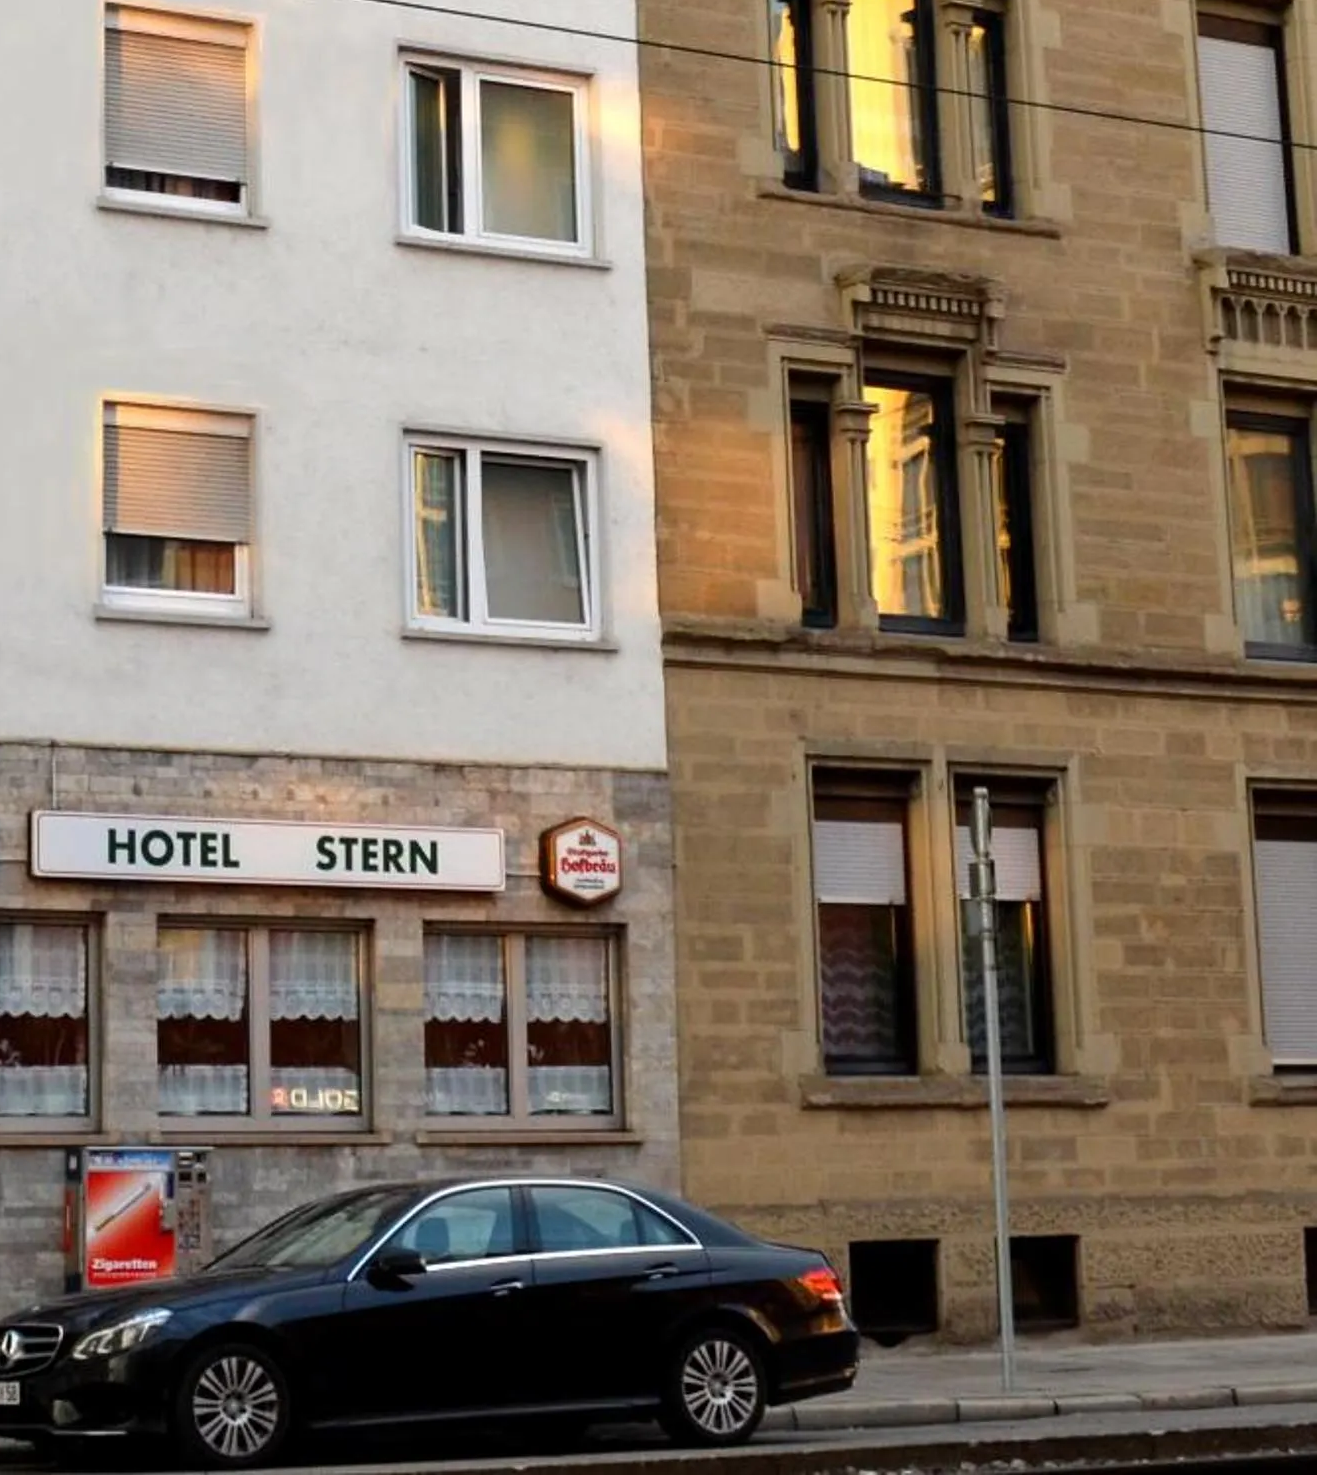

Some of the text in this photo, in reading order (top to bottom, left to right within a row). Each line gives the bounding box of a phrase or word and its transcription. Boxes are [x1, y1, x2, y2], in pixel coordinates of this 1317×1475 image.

[107, 828, 439, 875] HOTEL STERN
[91, 1257, 158, 1272] Zigaretten
